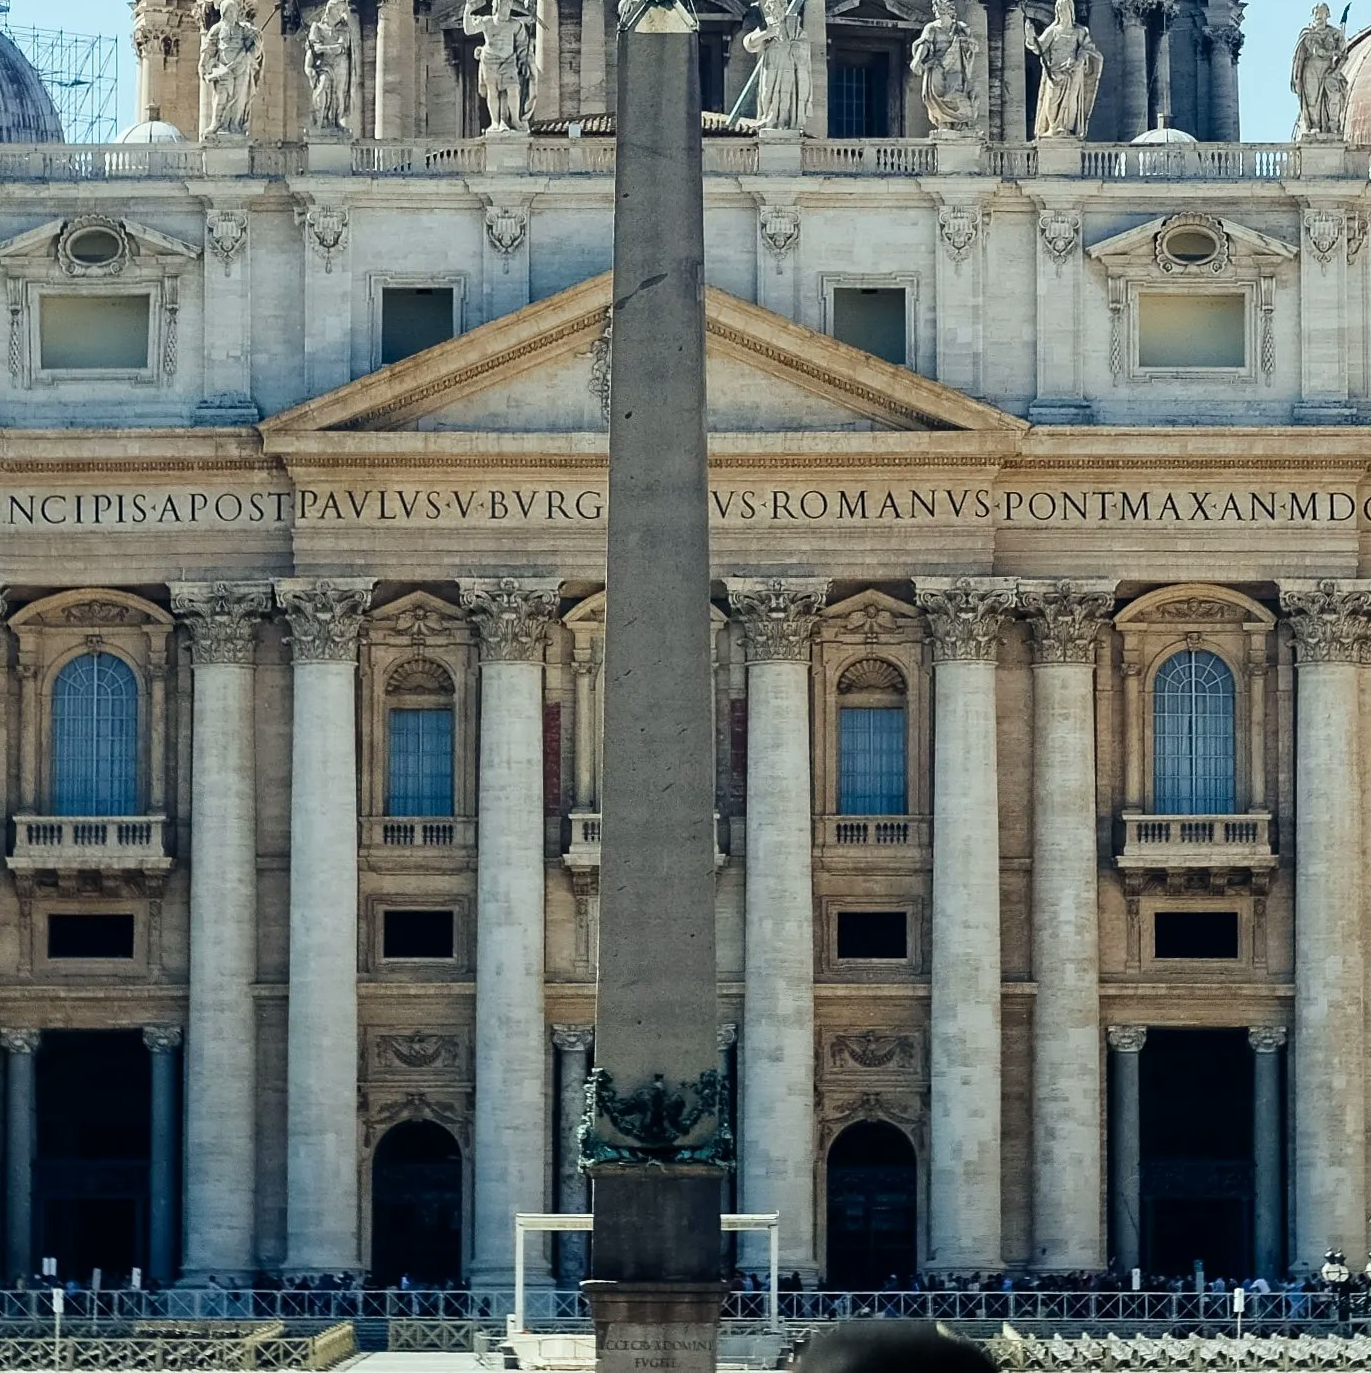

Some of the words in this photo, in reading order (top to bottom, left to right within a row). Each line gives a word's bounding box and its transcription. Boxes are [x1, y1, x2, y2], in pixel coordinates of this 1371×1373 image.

[156, 491, 292, 523] APOST
[298, 489, 441, 520] PAVLVS
[450, 490, 478, 519] V
[770, 489, 990, 520] ROMANVS
[1003, 491, 1111, 521] PONT
[1118, 491, 1211, 521] MAX
[1217, 491, 1277, 522] AN
